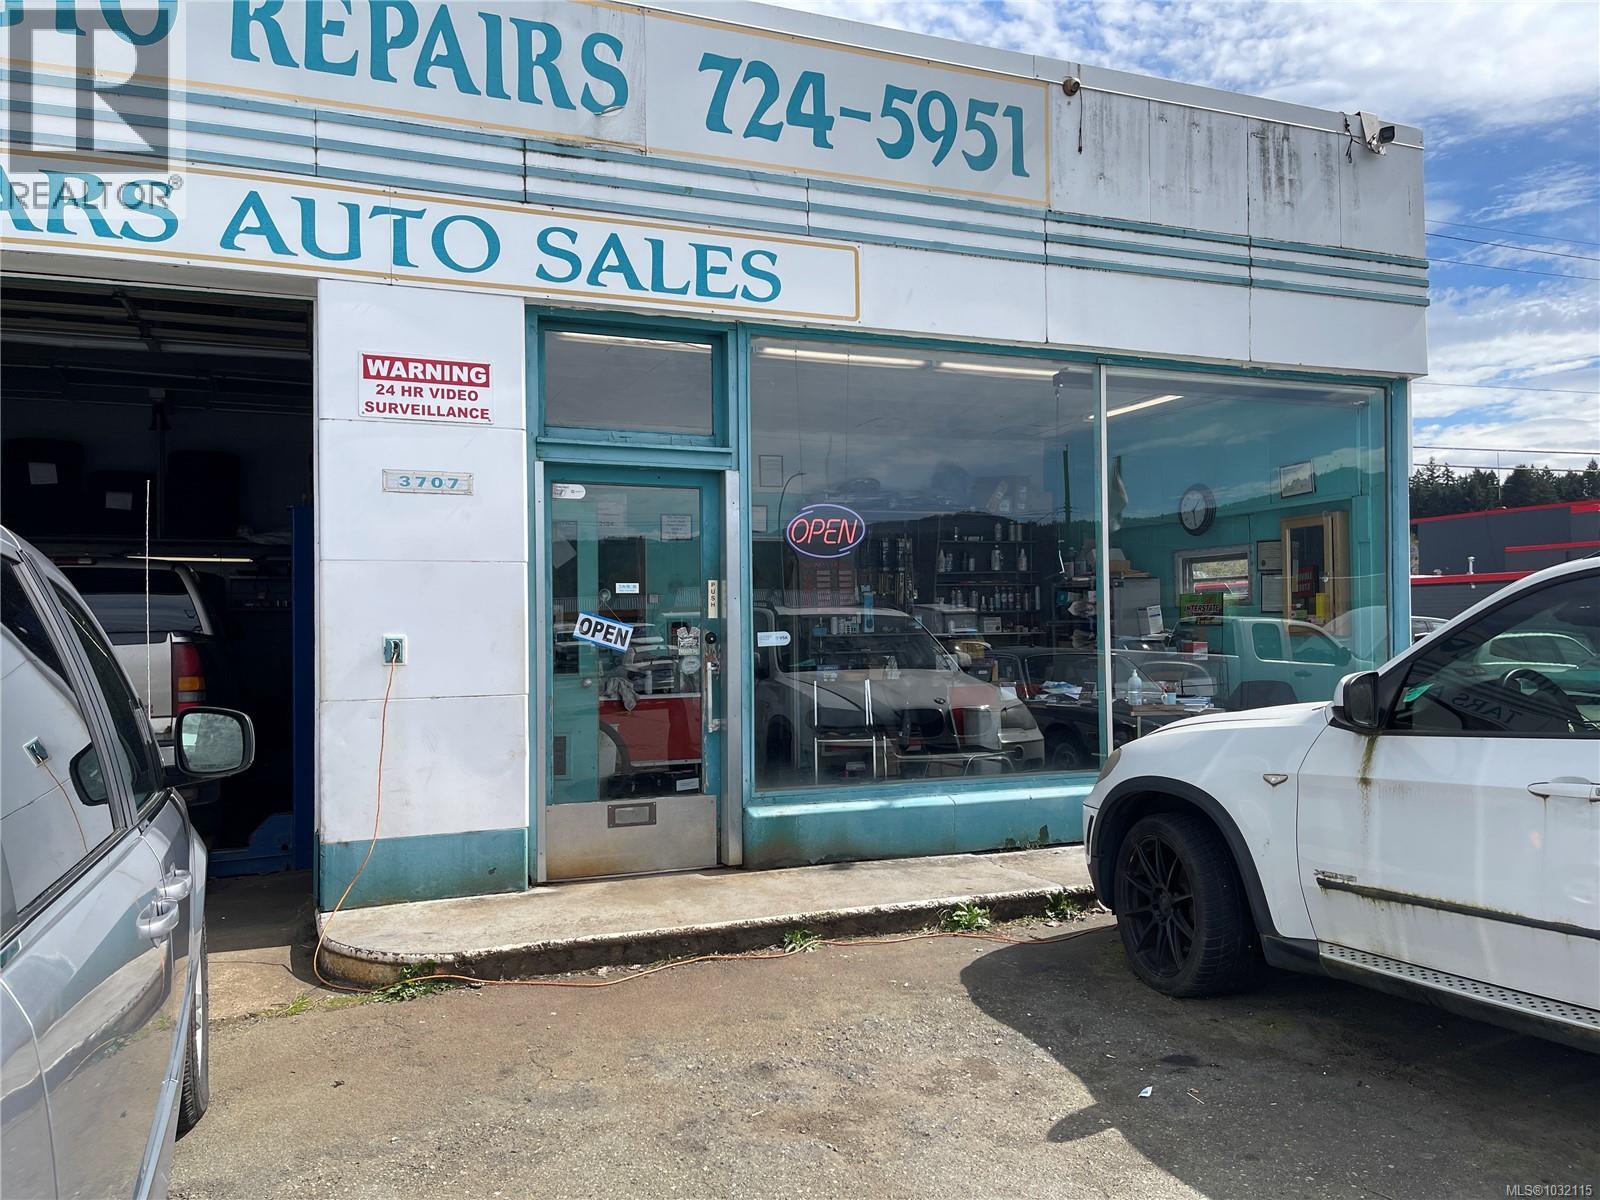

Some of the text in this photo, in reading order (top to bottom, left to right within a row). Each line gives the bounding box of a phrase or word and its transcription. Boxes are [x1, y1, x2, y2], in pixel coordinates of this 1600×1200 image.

[230, 0, 1031, 178] REPAIRS 724-5951
[220, 190, 501, 274] AUTO
[535, 226, 782, 302] SALES
[366, 358, 488, 384] WARNING
[375, 383, 479, 402] 24 HR VIDEO
[364, 401, 490, 420] SURVEILLANCE
[399, 475, 459, 489] 3707
[790, 518, 858, 544] OPEN
[578, 617, 630, 647] OPEN
